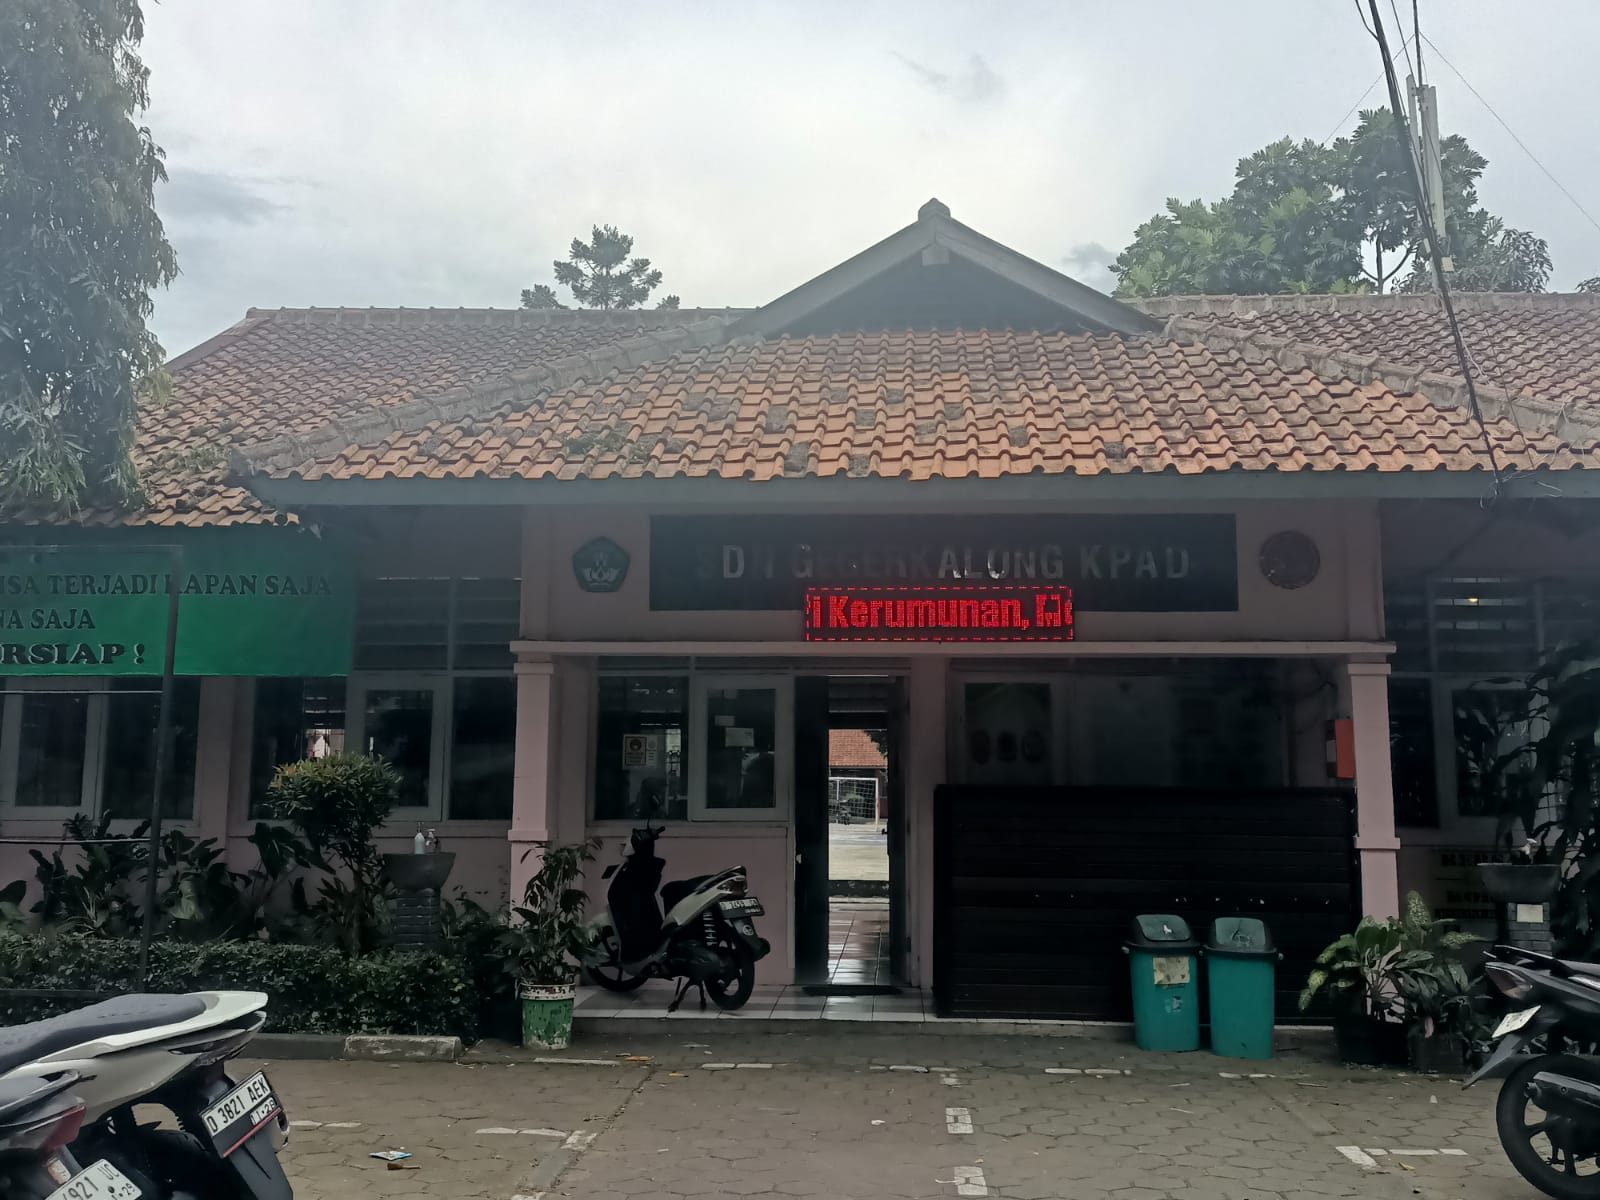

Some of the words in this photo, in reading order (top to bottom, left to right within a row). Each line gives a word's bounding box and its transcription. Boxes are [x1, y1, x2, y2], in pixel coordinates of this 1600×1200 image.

[1079, 543, 1190, 580] KPAD
[47, 574, 158, 595] TERJADI
[264, 574, 337, 595] SAJA
[30, 608, 97, 630] SAJA
[829, 595, 1030, 631] Kerumunan,
[206, 1115, 218, 1133] D
[217, 1095, 245, 1124] 3821
[246, 1077, 269, 1102] AEK
[97, 1163, 120, 1180] UC
